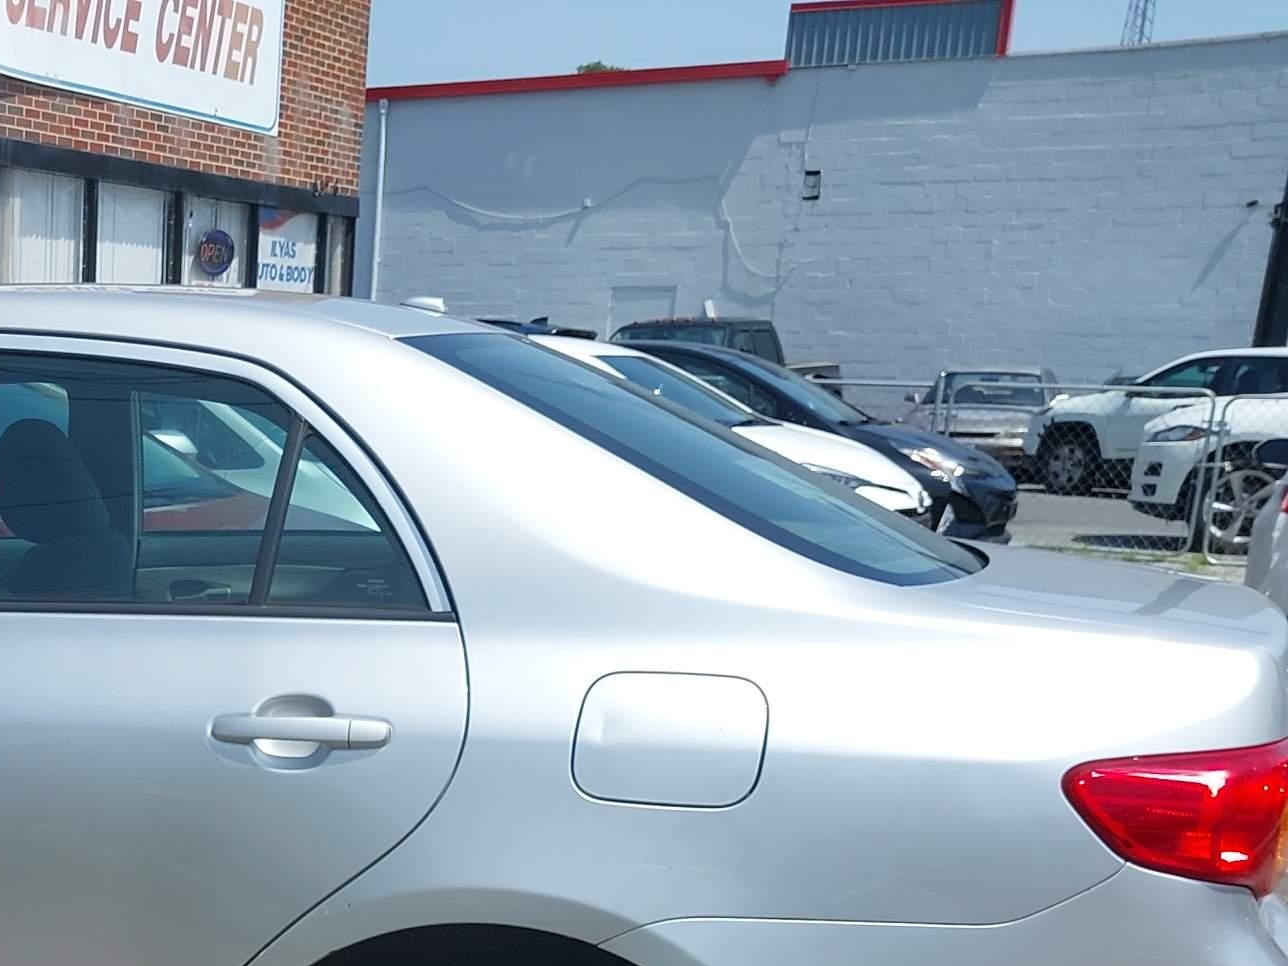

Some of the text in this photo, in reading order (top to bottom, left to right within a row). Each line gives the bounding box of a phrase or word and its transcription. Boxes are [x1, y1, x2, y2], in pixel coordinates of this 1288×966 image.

[156, 0, 264, 86] CENTER
[200, 243, 229, 262] OPEN
[270, 240, 297, 258] ILYAS
[286, 266, 314, 284] BODY
